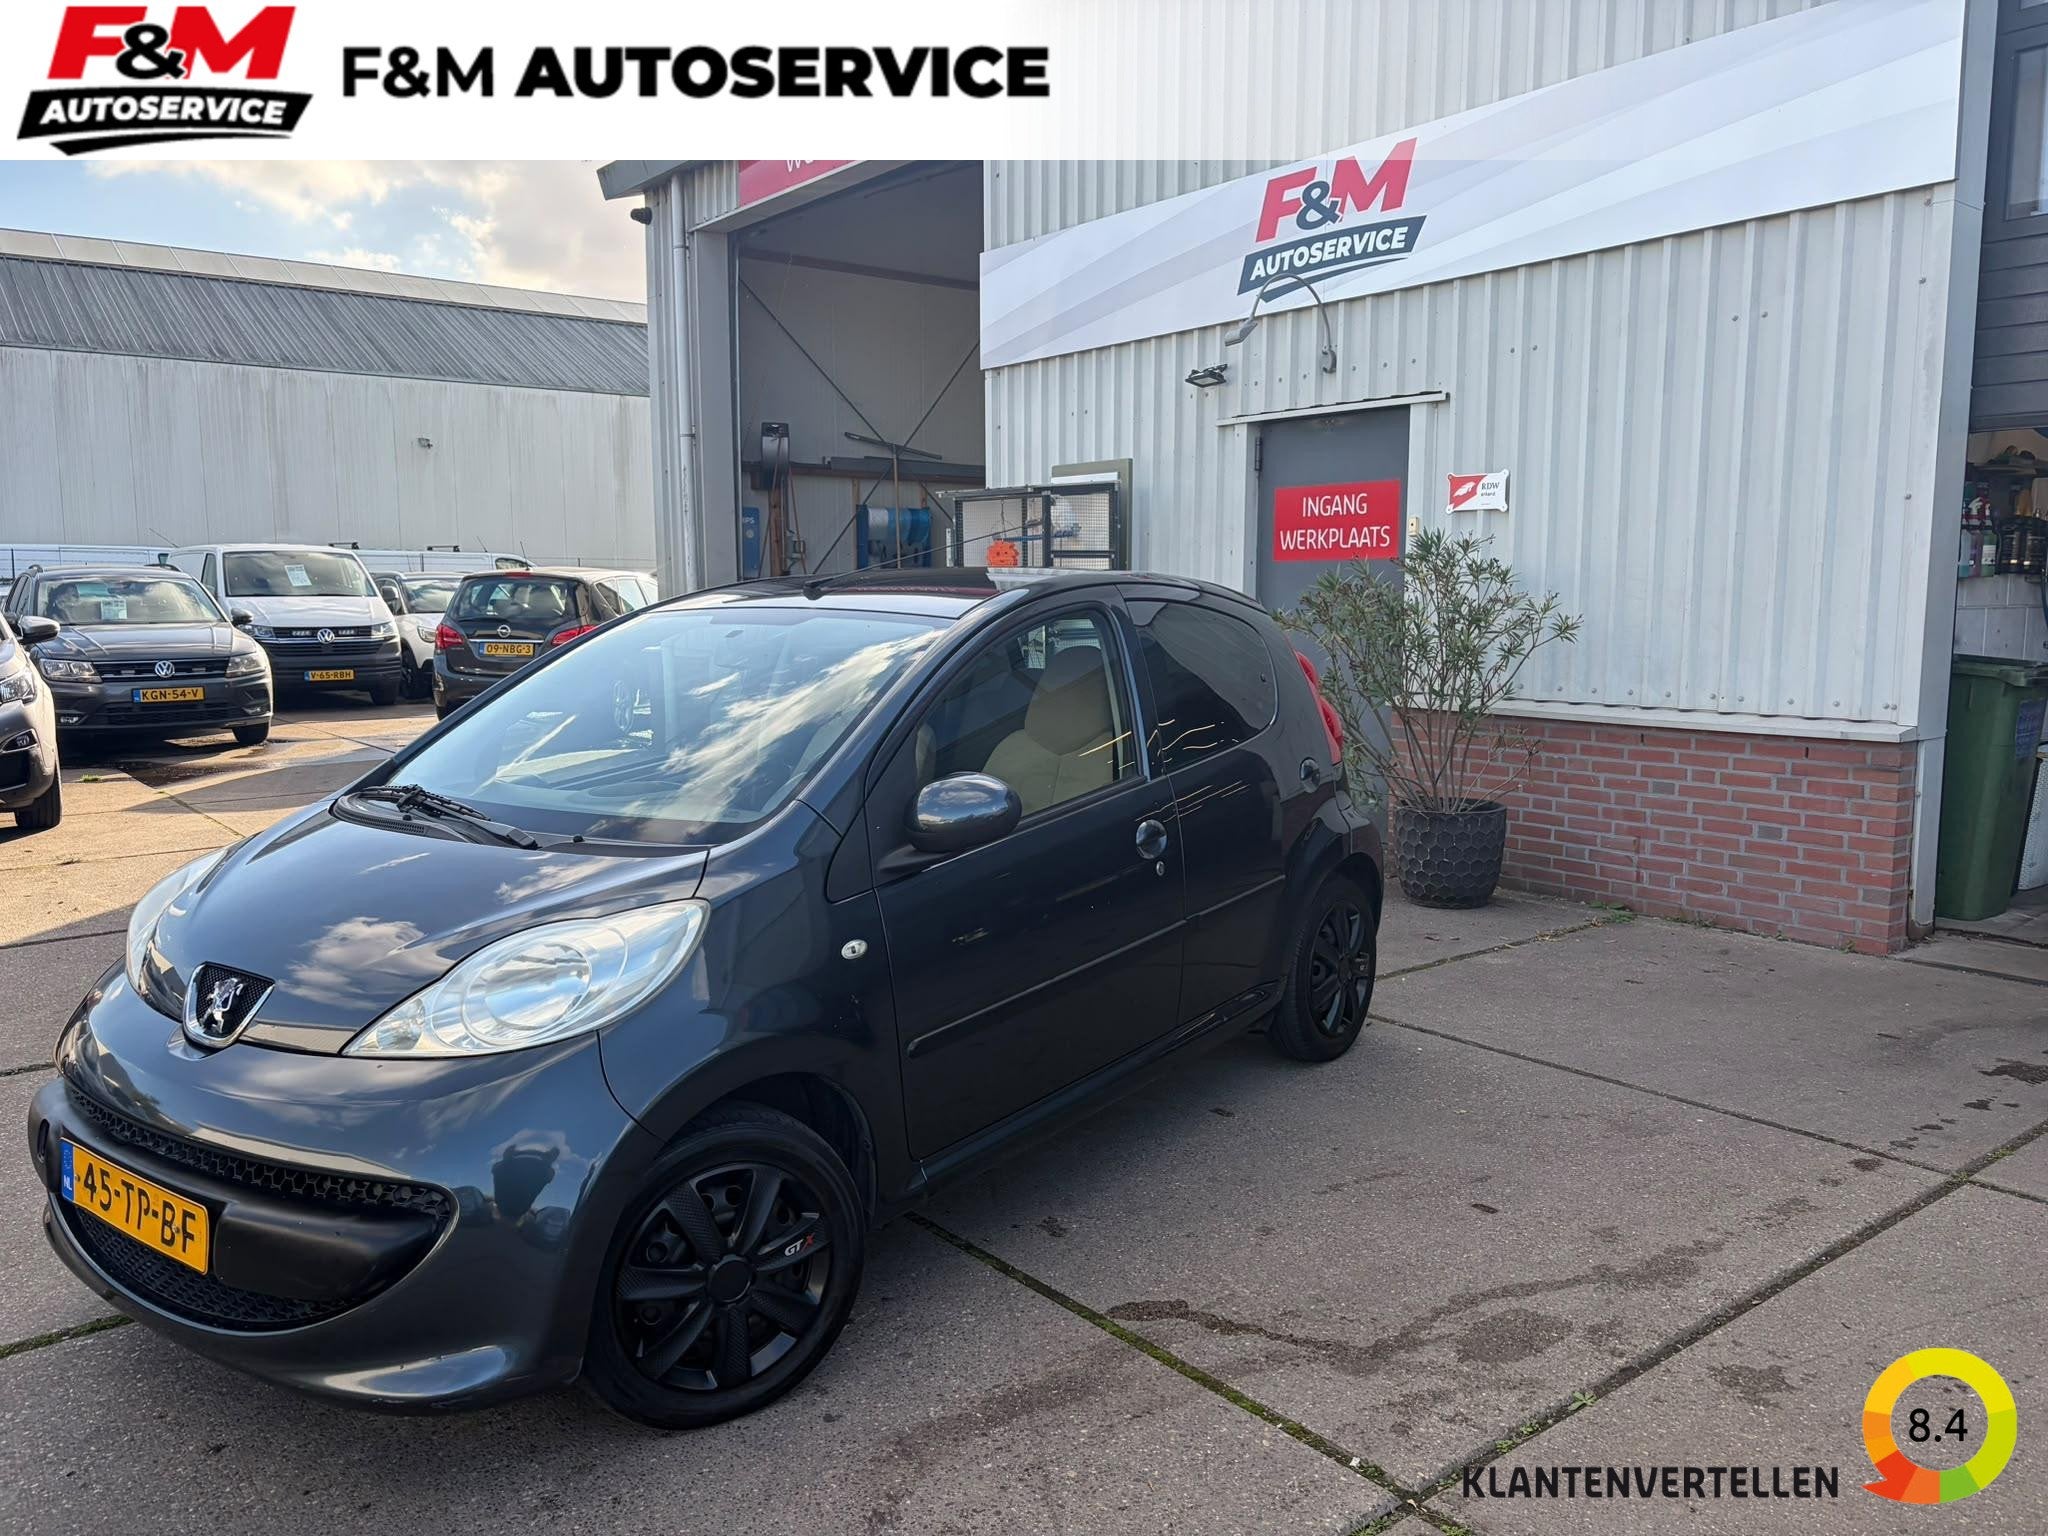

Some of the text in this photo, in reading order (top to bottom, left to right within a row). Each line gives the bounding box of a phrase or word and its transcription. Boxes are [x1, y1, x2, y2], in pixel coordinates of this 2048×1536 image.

[1255, 137, 1418, 243] F&M
[1249, 226, 1409, 281] AUTOSERVICE
[1481, 481, 1500, 490] RDW
[1302, 493, 1368, 518] INGANG
[1280, 525, 1391, 551] WERKPLAATS
[486, 644, 531, 653] 09-NBG-3
[310, 671, 351, 680] V-65-RBH
[142, 688, 199, 701] KGN-54-V
[83, 1162, 197, 1254] 45-TP-BF
